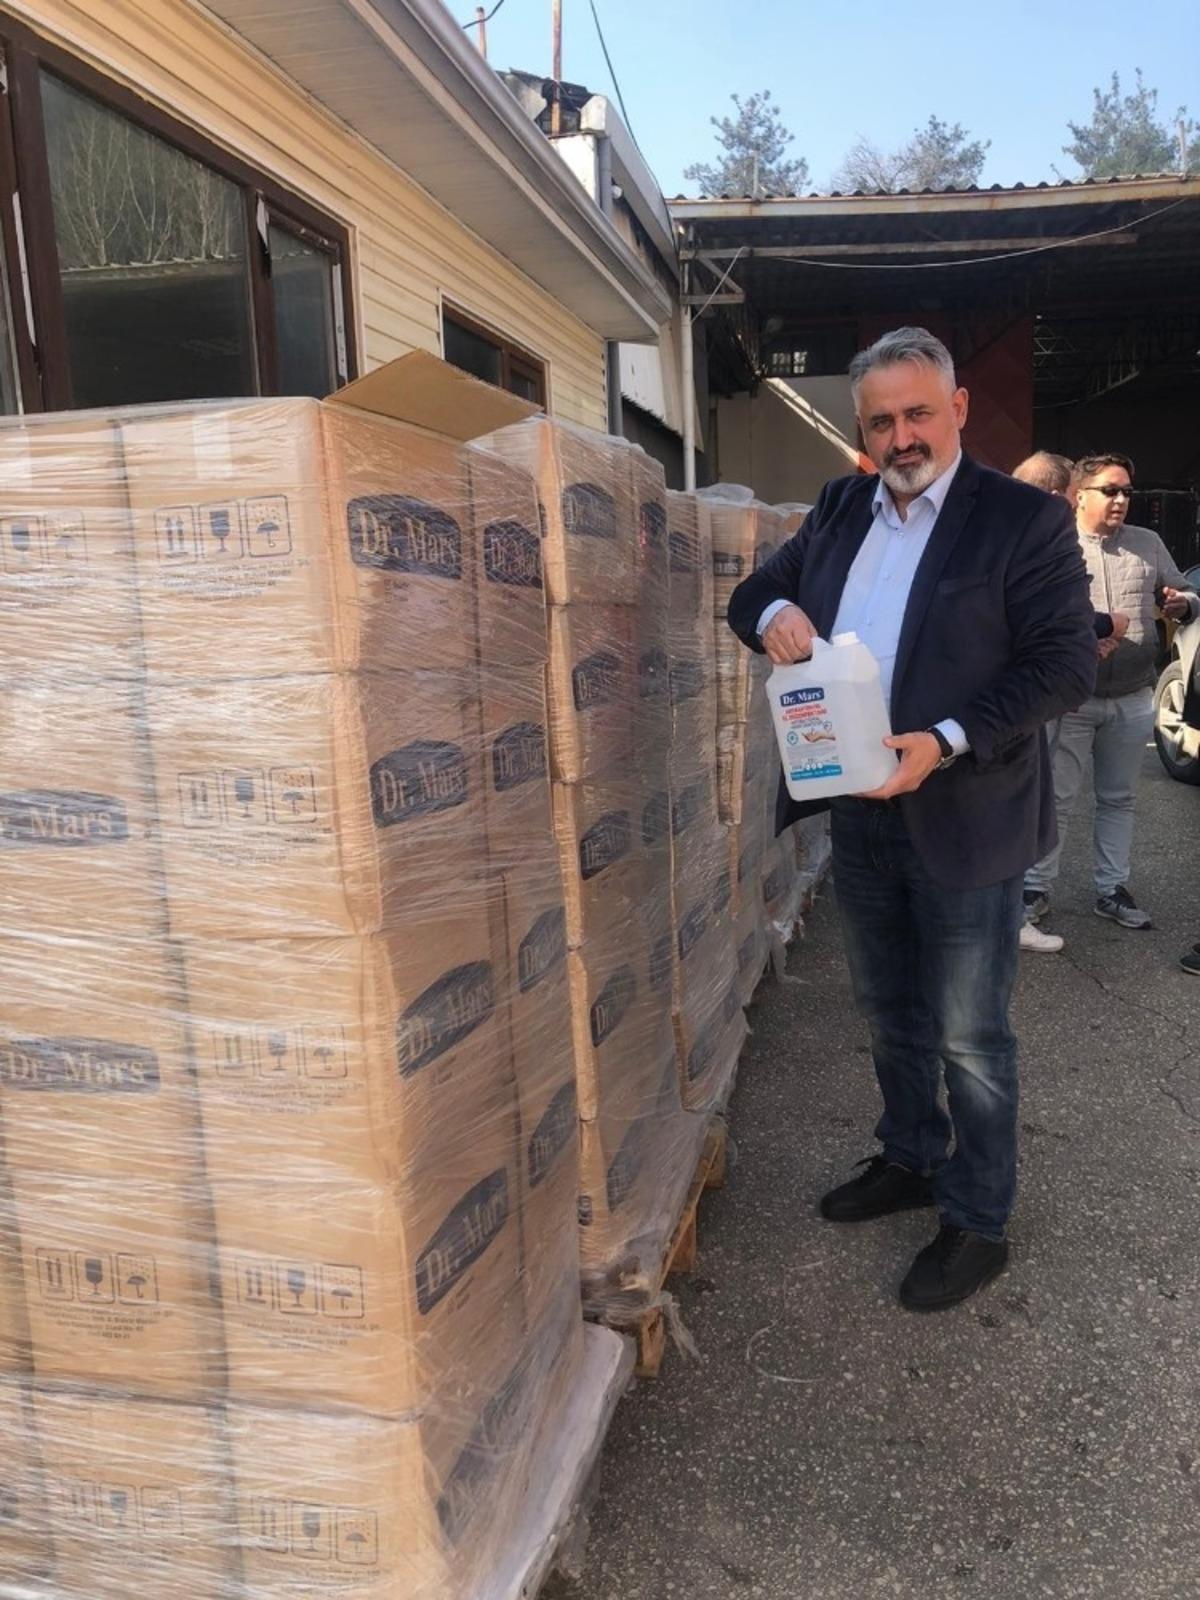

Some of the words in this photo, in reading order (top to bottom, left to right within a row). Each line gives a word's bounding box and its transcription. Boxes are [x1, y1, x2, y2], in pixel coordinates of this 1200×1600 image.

[358, 508, 399, 558] Dr.
[403, 516, 459, 565] Mars
[783, 695, 796, 705] Dr.
[798, 691, 821, 702] Mars
[380, 768, 415, 812] Dr.
[418, 760, 464, 801] Mars
[29, 804, 112, 838] Mars
[405, 1015, 441, 1059] Dr.
[8, 1052, 51, 1082] Dr.
[64, 1051, 146, 1084] Mars
[424, 1249, 460, 1295] Dr.
